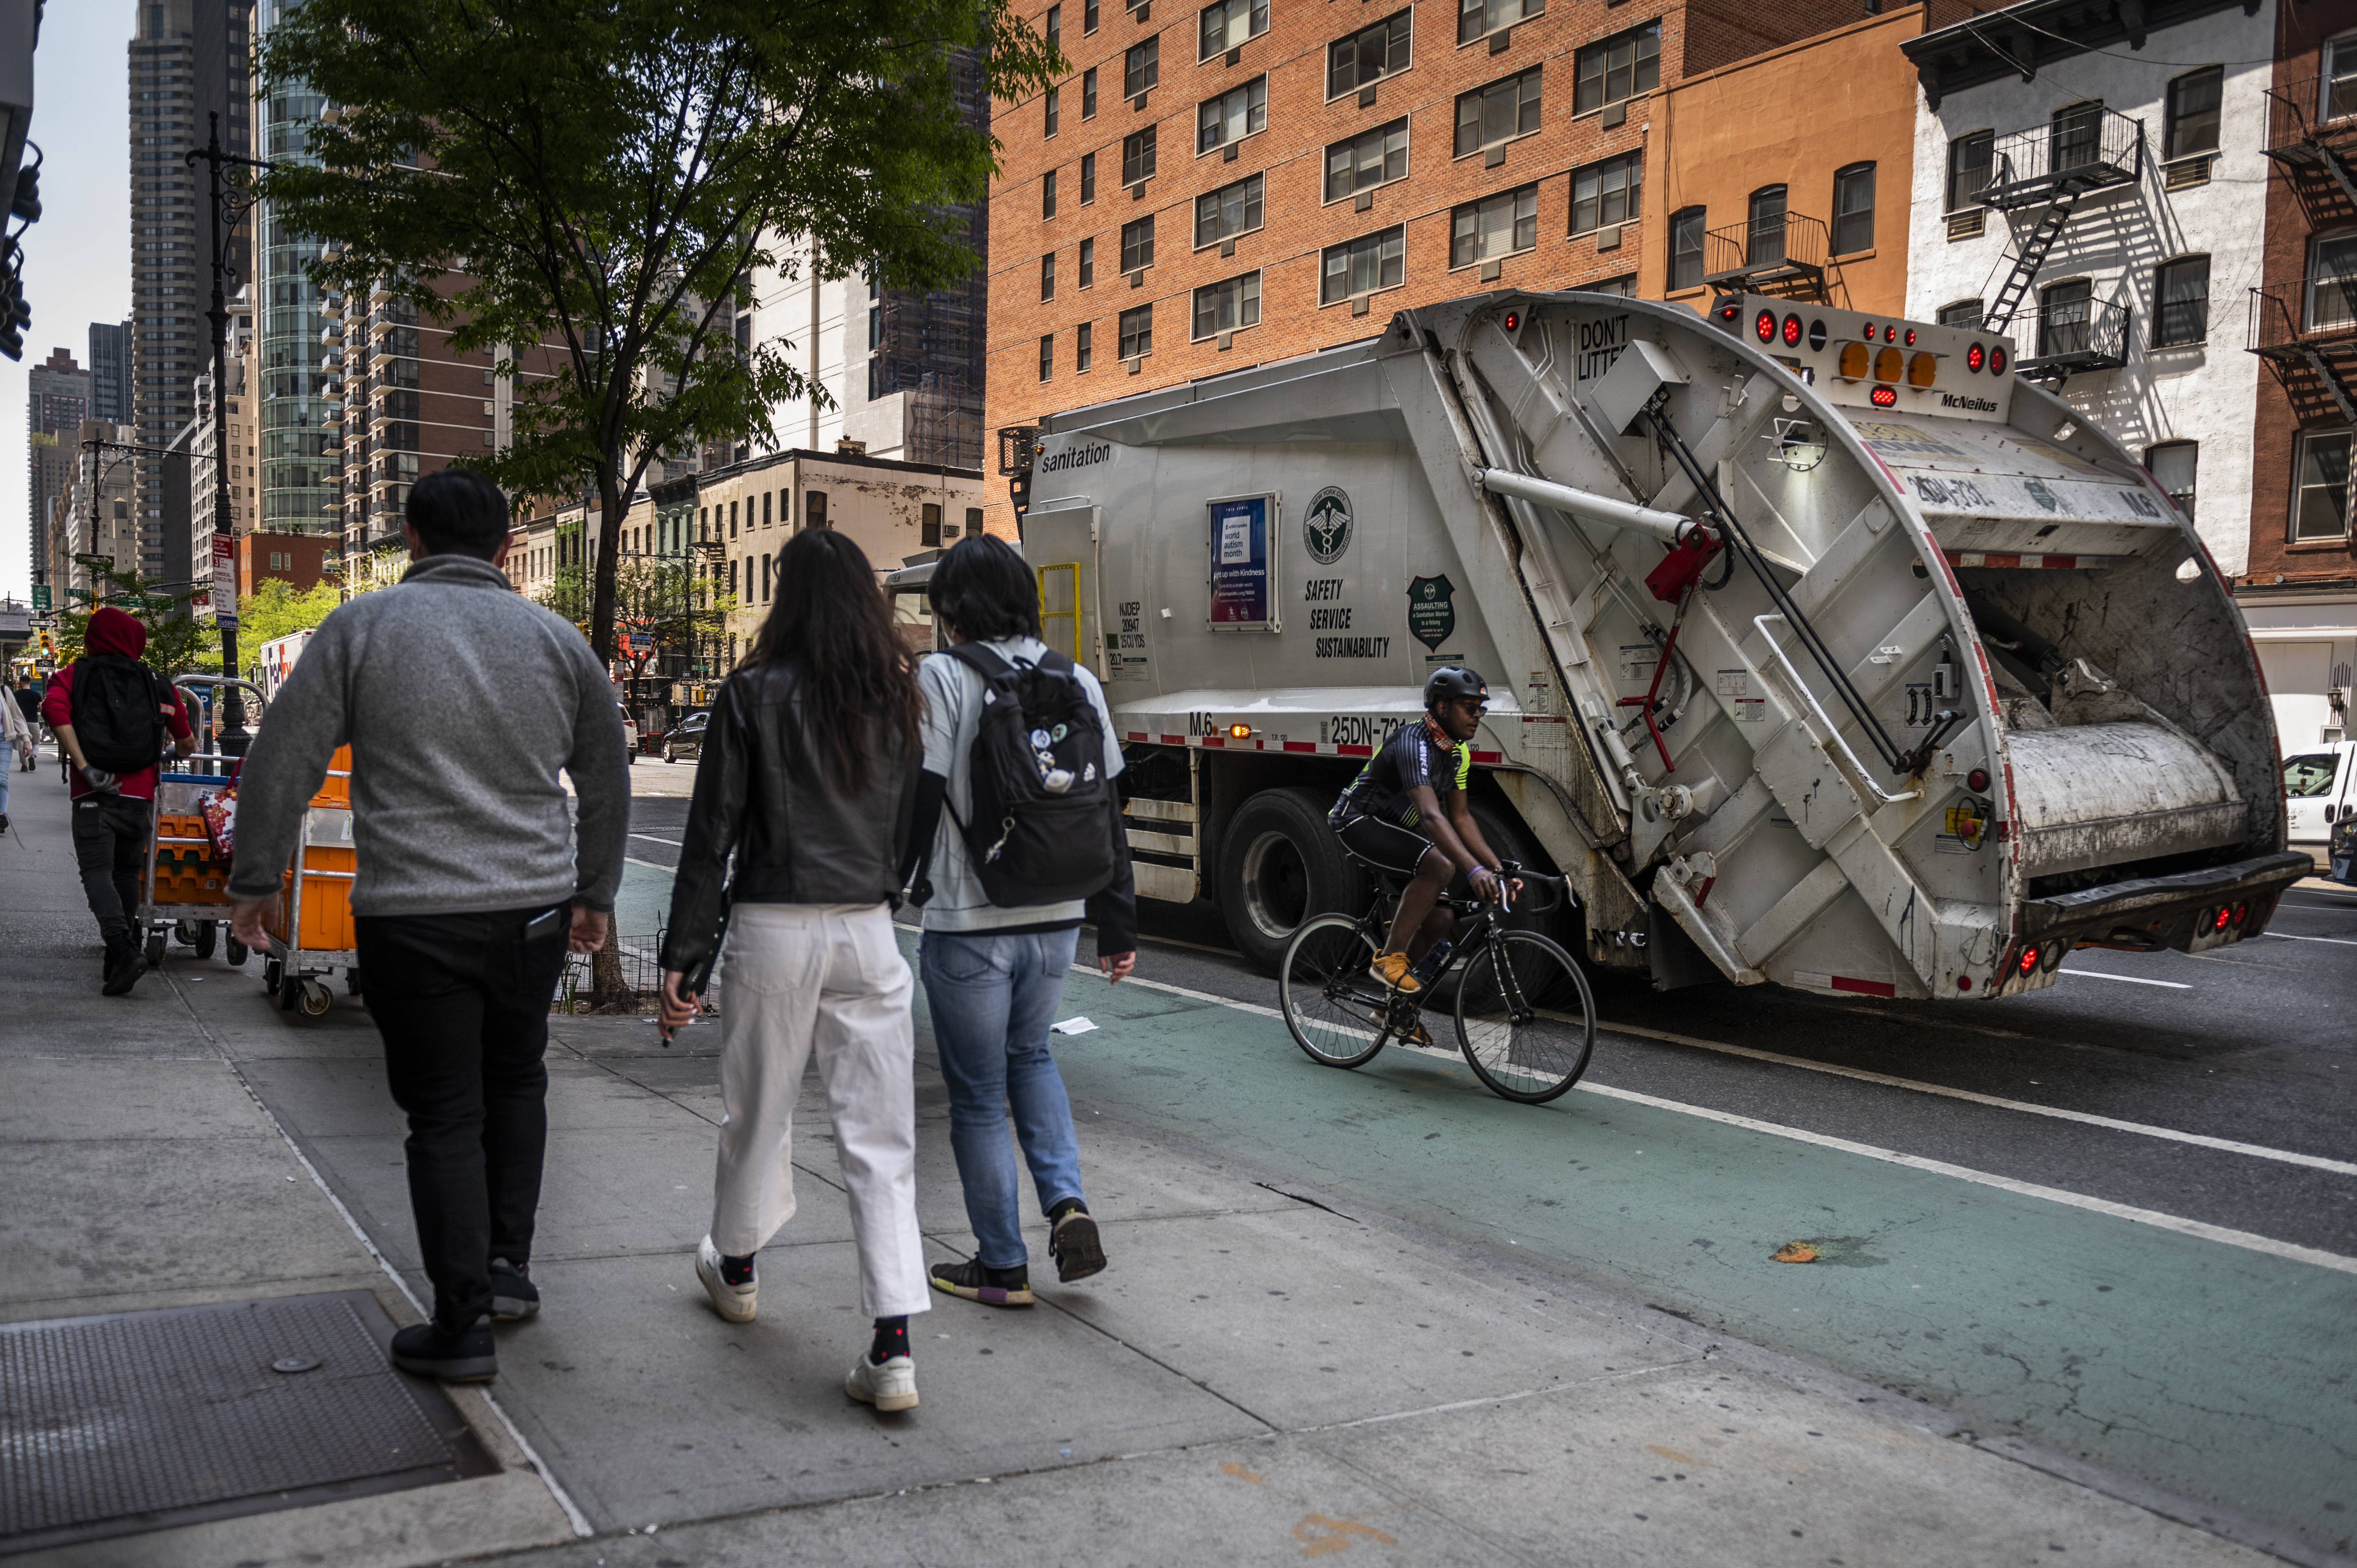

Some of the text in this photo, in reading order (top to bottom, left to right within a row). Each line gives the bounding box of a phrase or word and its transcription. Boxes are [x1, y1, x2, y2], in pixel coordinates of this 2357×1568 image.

[1581, 313, 1629, 351] DON'T
[1578, 344, 1629, 381] LITTE
[1940, 394, 1998, 412] McNeilus
[1042, 442, 1110, 473] sanitation
[1312, 493, 1322, 506] NEW
[1336, 491, 1346, 502] CITY
[1225, 531, 1240, 539] world
[1224, 540, 1243, 549] autism
[1305, 533, 1324, 562] DEPARTMENT
[1331, 529, 1351, 560] SANITATION
[1224, 549, 1242, 558] month
[215, 558, 218, 567] 3
[1306, 579, 1344, 601] SAFETY
[1119, 601, 1140, 616] NJDEP
[1414, 601, 1448, 609] ASSAULTING
[1122, 618, 1139, 632] 20947
[1310, 608, 1352, 629] SERVICE
[1121, 634, 1127, 648] 25
[1127, 634, 1134, 648] CU
[1134, 633, 1145, 648] YDS
[1316, 637, 1390, 658] SUSTAINABILITY
[1110, 653, 1122, 666] 20.7
[1189, 712, 1213, 737] M.6
[1332, 716, 1406, 745] 25DN-73
[1470, 743, 1479, 751] 120
